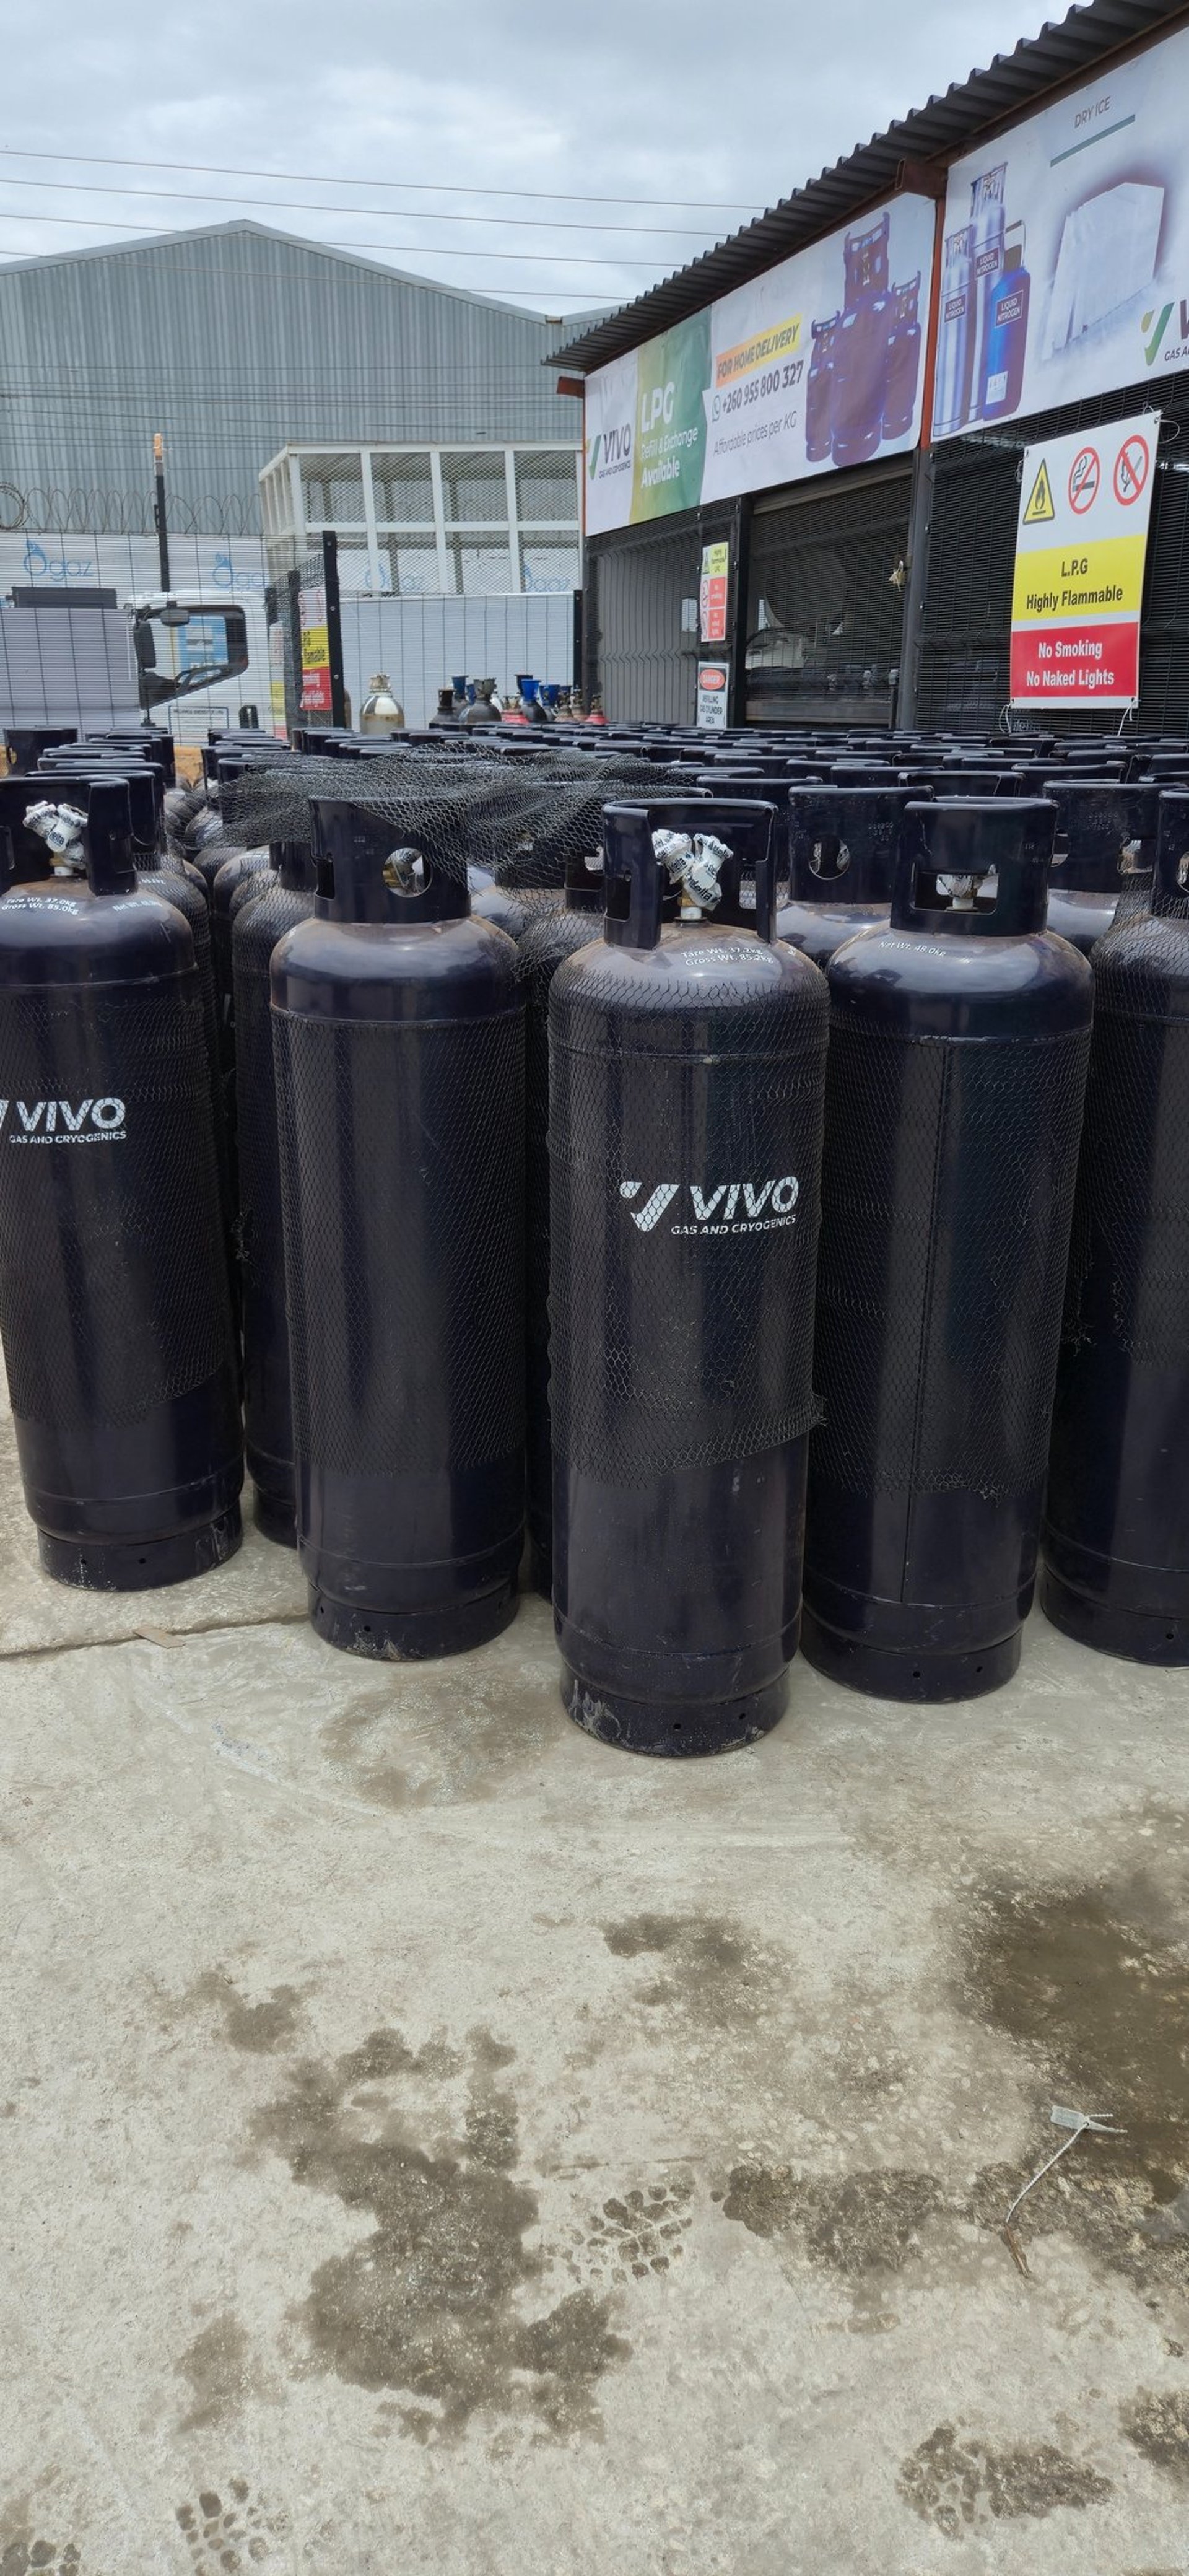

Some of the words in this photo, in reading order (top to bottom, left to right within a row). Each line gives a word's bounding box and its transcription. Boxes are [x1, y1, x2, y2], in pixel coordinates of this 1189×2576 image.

[1074, 104, 1094, 128] DRY
[1095, 95, 1110, 116] ICE
[980, 252, 995, 265] LIQUID
[997, 307, 1021, 322] NITROGEN
[1001, 298, 1017, 312] LIQUID
[716, 359, 733, 379] FOR
[733, 345, 756, 372] HOME
[756, 322, 800, 360] DELIVERY
[1165, 347, 1181, 361] GAS
[722, 388, 742, 414] +260
[744, 378, 759, 405] 955
[760, 369, 780, 398] 800
[782, 359, 804, 389] 327
[642, 381, 676, 434] LPG
[603, 422, 632, 465] VIVO
[663, 427, 699, 452] Exchange
[713, 431, 746, 456] Affordable
[747, 422, 768, 448] prices
[769, 419, 782, 439] per
[783, 410, 798, 429] KG
[640, 455, 680, 489] Available
[1061, 558, 1088, 577] L.P.G
[1026, 592, 1058, 612] Highly
[1061, 585, 1123, 606] Flammable
[1038, 642, 1052, 659] No
[1055, 639, 1102, 660] Smoking
[1026, 671, 1040, 686] No
[1043, 669, 1075, 686] Naked
[1078, 668, 1115, 689] Lights
[47, 904, 79, 915] 85.0kg
[681, 950, 704, 959] Tare
[686, 956, 716, 966] Gross
[17, 1097, 126, 1132] VIVO
[9, 1135, 28, 1143] GAS
[30, 1135, 53, 1144] AND
[55, 1130, 126, 1143] CRYOGENICS
[690, 1176, 799, 1220] VIVO
[671, 1226, 697, 1235] GAS
[700, 1224, 728, 1234] AND
[732, 1215, 796, 1233] CRYOGENICS
